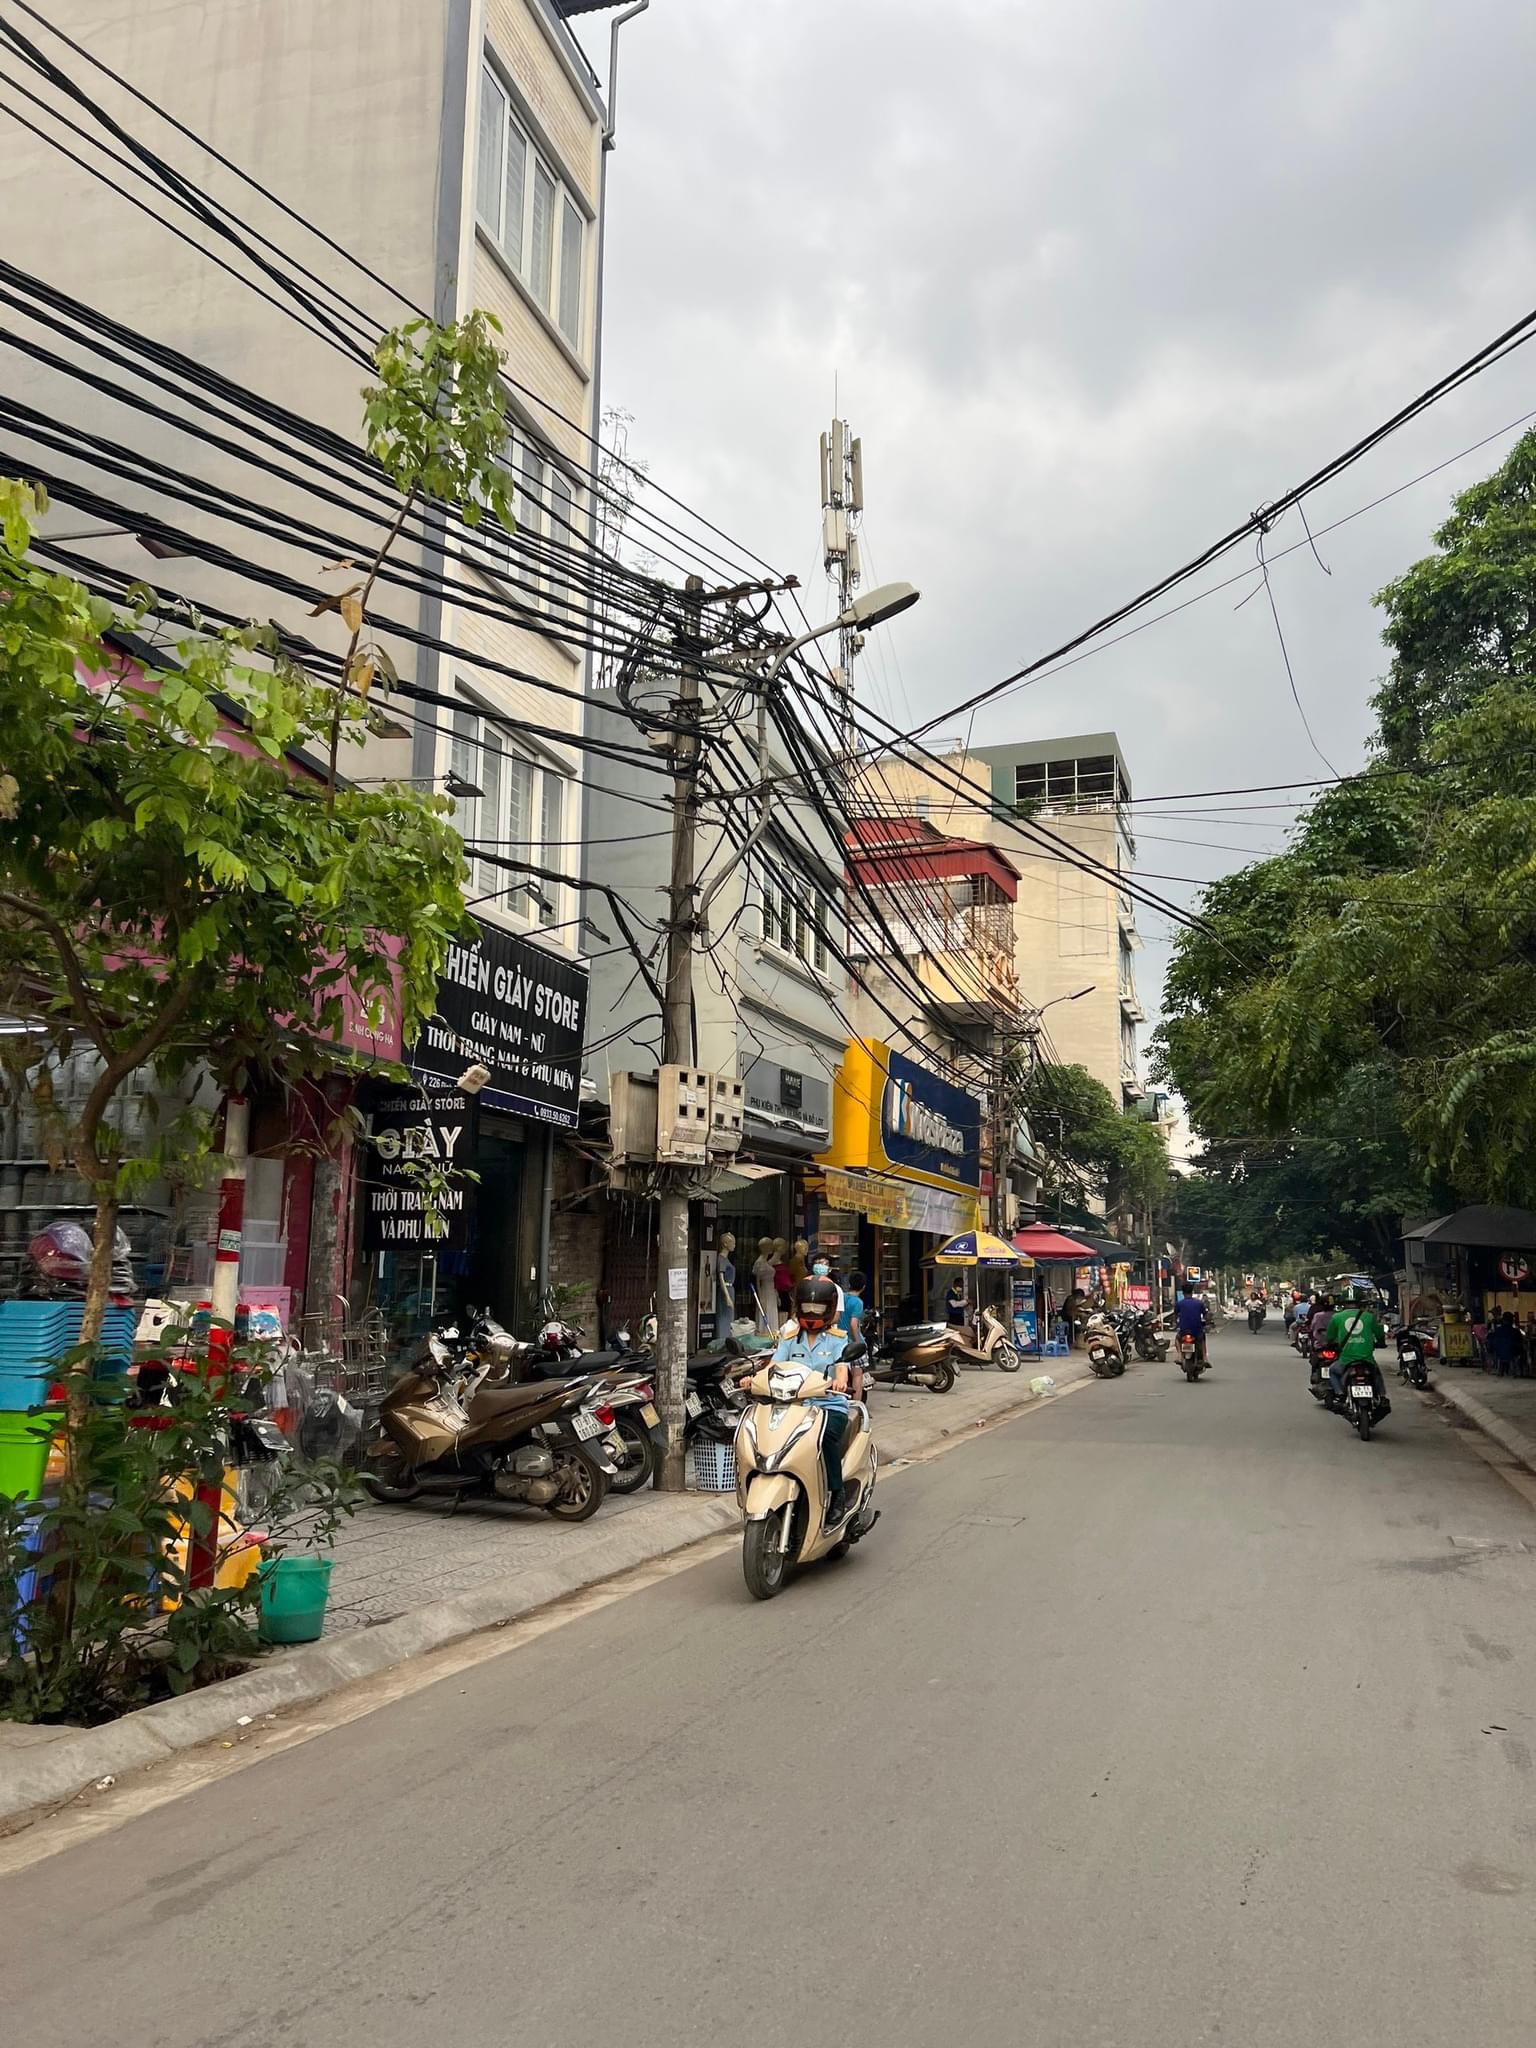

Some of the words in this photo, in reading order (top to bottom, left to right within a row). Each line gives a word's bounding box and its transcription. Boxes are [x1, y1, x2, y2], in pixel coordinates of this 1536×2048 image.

[444, 940, 491, 995] HIẾN
[494, 964, 534, 1012] GIÀY
[534, 983, 580, 1032] STORE
[471, 1010, 498, 1037] GIÀY
[500, 1020, 522, 1046] NAM
[530, 1032, 546, 1055] NỮ
[459, 1035, 495, 1066] TRANG
[497, 1048, 520, 1073] NAM
[531, 1061, 553, 1087] PHỤ
[554, 1067, 575, 1093] KIỆN
[428, 1076, 441, 1088] 226
[409, 1096, 433, 1111] GIÀY
[434, 1097, 466, 1111] STORE
[377, 1117, 463, 1160] GIÀY
[371, 1188, 398, 1212] THỜI
[438, 1190, 463, 1210] NAM
[381, 1215, 399, 1239] VÀ
[398, 1219, 422, 1243] PHỤ
